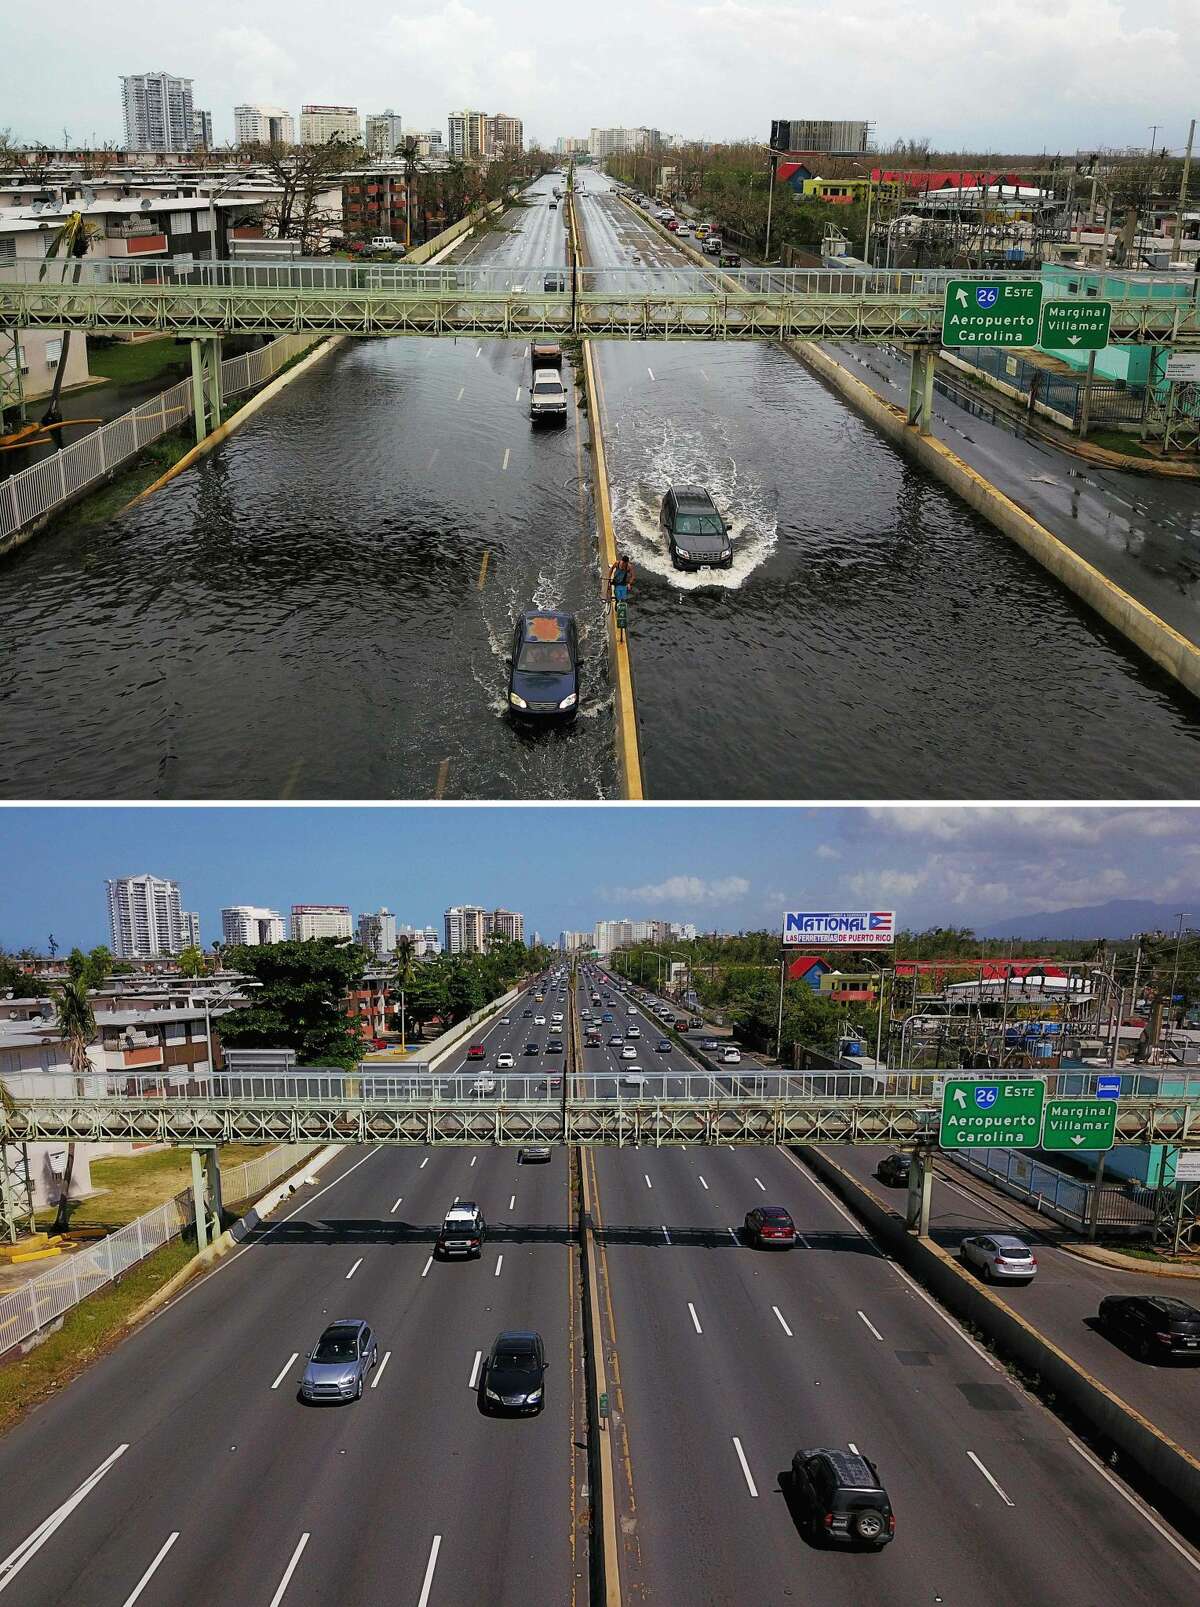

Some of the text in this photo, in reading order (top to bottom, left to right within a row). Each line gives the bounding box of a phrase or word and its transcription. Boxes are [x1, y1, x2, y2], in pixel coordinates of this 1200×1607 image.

[977, 289, 996, 302] 26
[1049, 307, 1106, 319] Marginal
[950, 314, 1034, 327] Aeropuerto
[1048, 321, 1104, 330] Villamar
[959, 330, 1023, 341] Carolina
[976, 1090, 995, 1102] 26
[1051, 1107, 1112, 1119] Marginal
[948, 1115, 1036, 1128] Aeropuerto
[1051, 1121, 1109, 1130] Villamar
[957, 1132, 1024, 1142] Carolina
